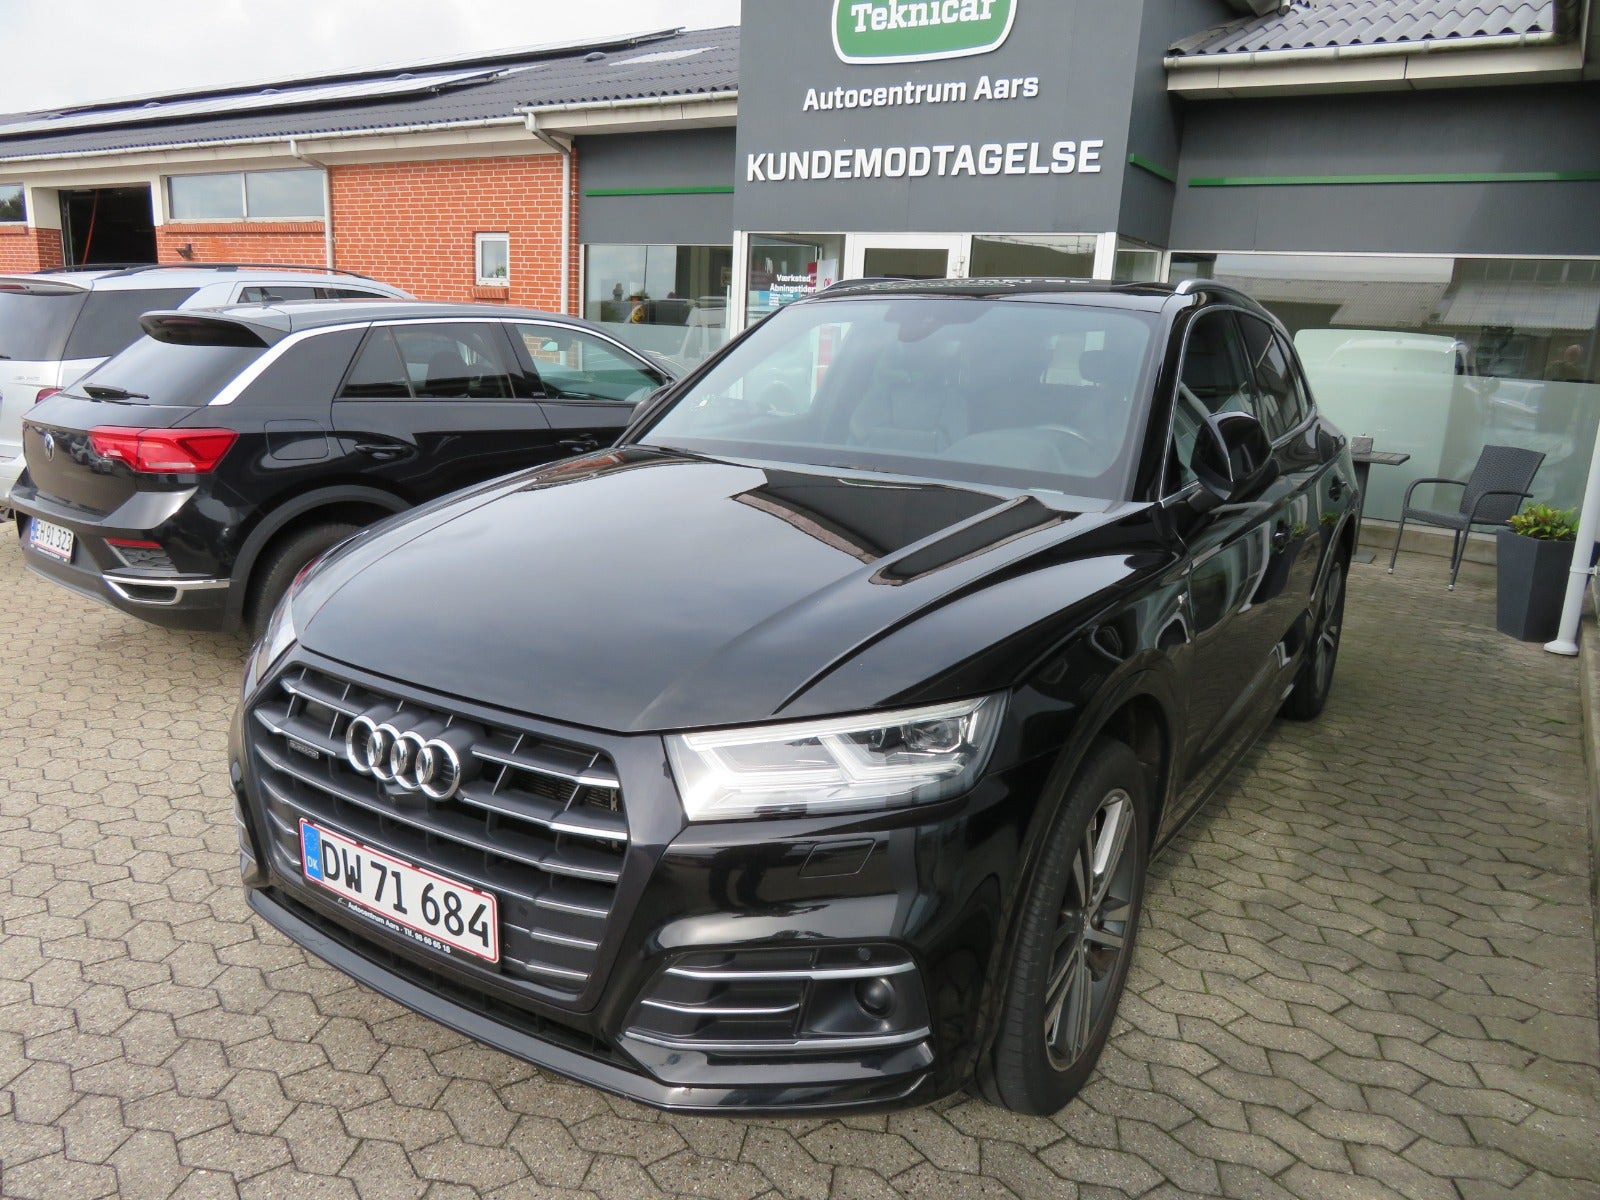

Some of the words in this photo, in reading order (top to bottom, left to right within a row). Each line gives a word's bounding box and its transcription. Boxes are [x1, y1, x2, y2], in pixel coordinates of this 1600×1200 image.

[851, 0, 996, 32] Teknicar
[802, 80, 967, 111] Autocentrum
[974, 75, 1040, 100] Aars
[746, 139, 1104, 182] KUNDEMODTAGELSE
[776, 274, 811, 282] Værksted
[56, 529, 73, 552] 323
[307, 855, 319, 871] DK
[321, 839, 362, 893] DW
[370, 860, 408, 915] 71
[421, 882, 489, 948] 684
[347, 901, 385, 925] Autocentrum
[385, 919, 400, 932] Aars
